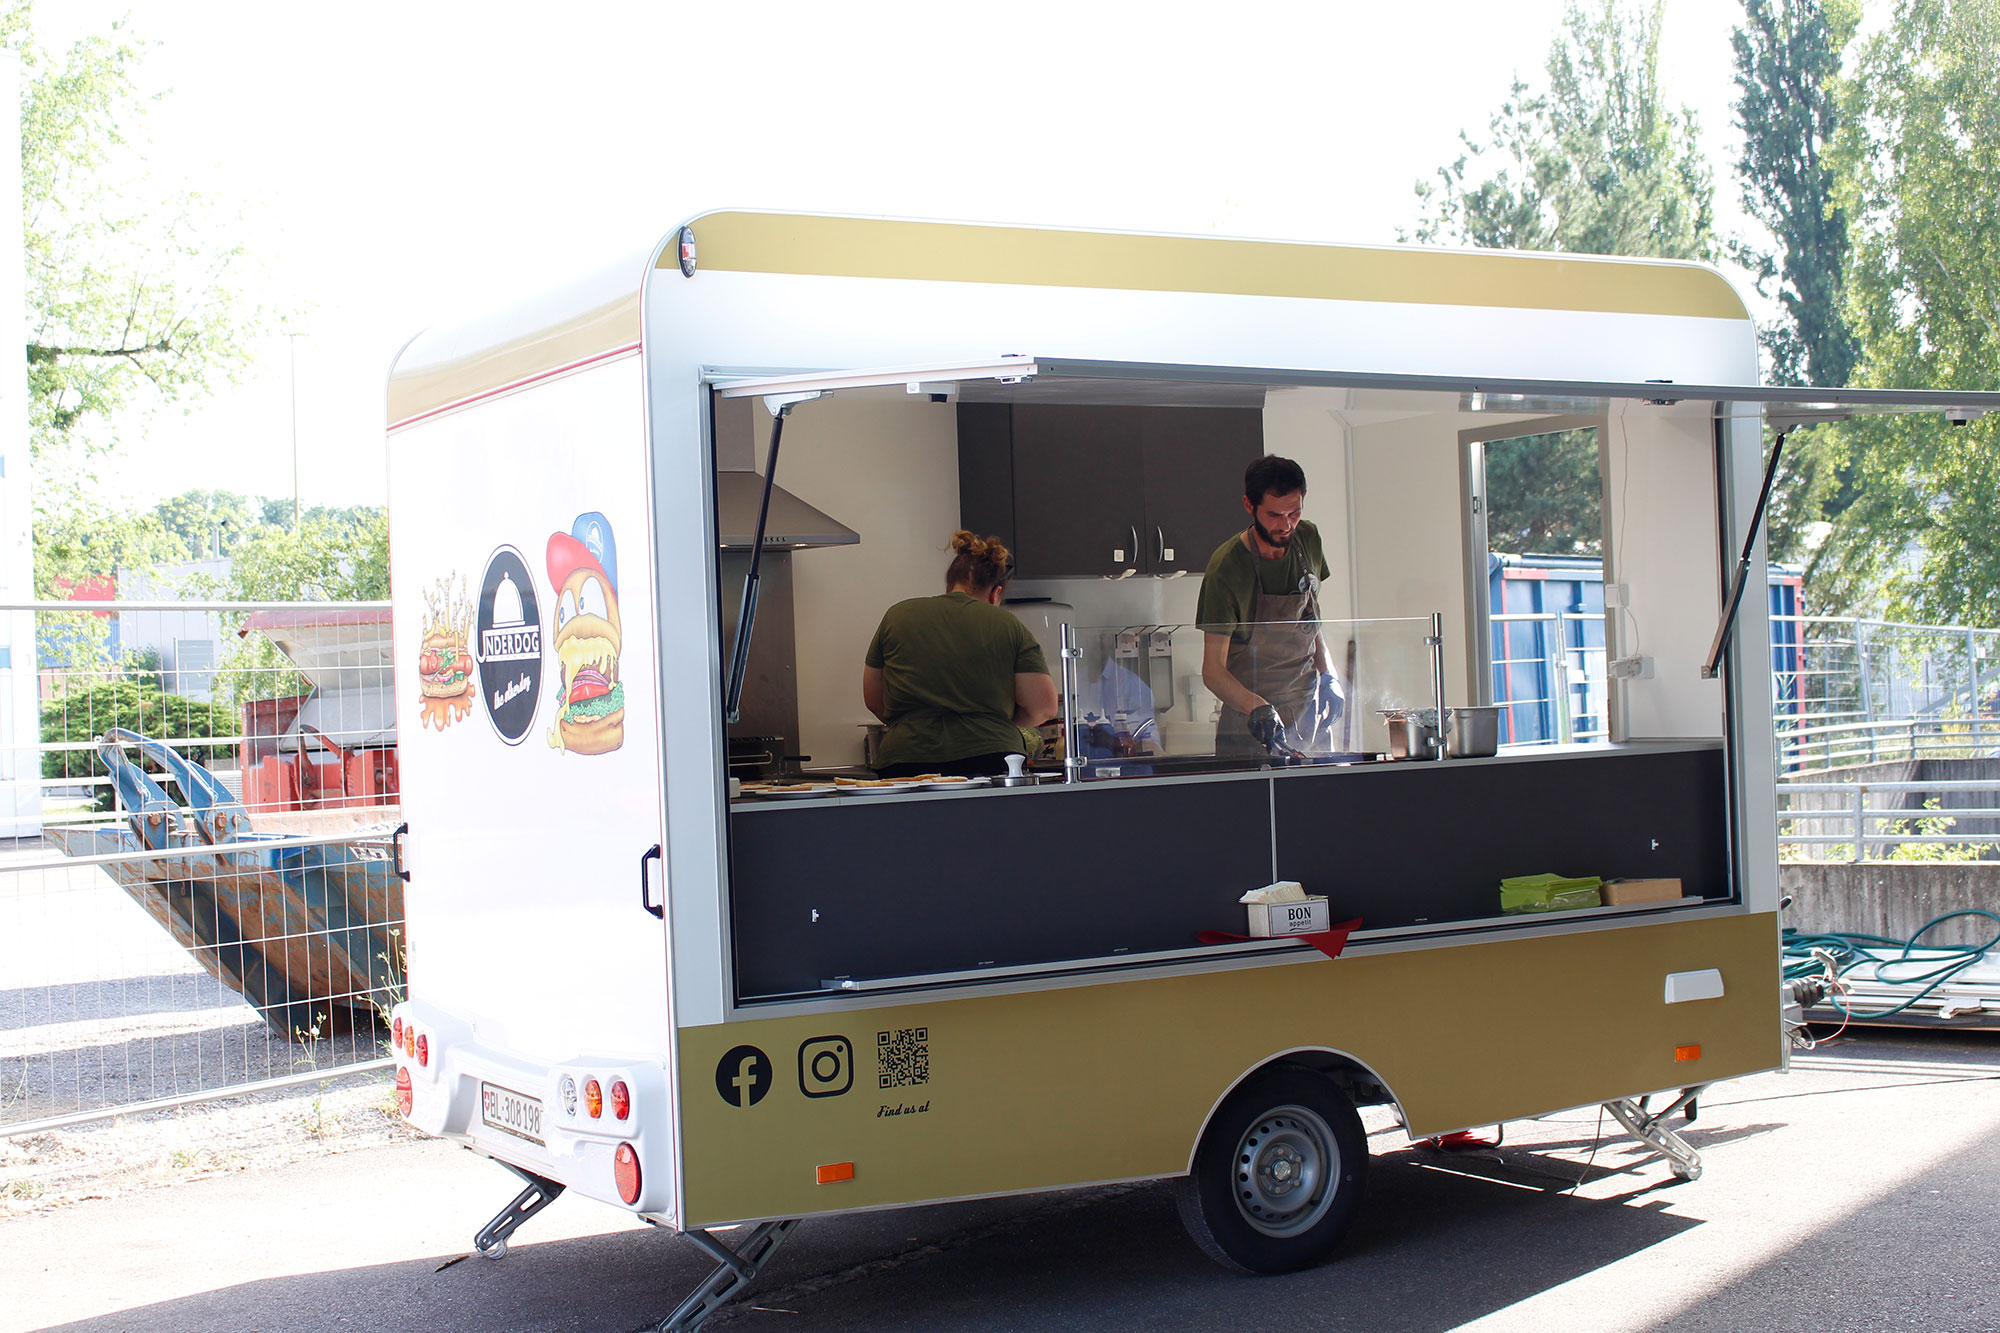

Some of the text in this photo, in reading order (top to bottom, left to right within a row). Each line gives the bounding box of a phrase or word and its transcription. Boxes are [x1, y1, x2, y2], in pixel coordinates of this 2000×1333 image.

[477, 630, 540, 664] UNDERDOG
[1287, 906, 1311, 920] BON
[877, 1103, 903, 1118] Find
[903, 1105, 916, 1115] us
